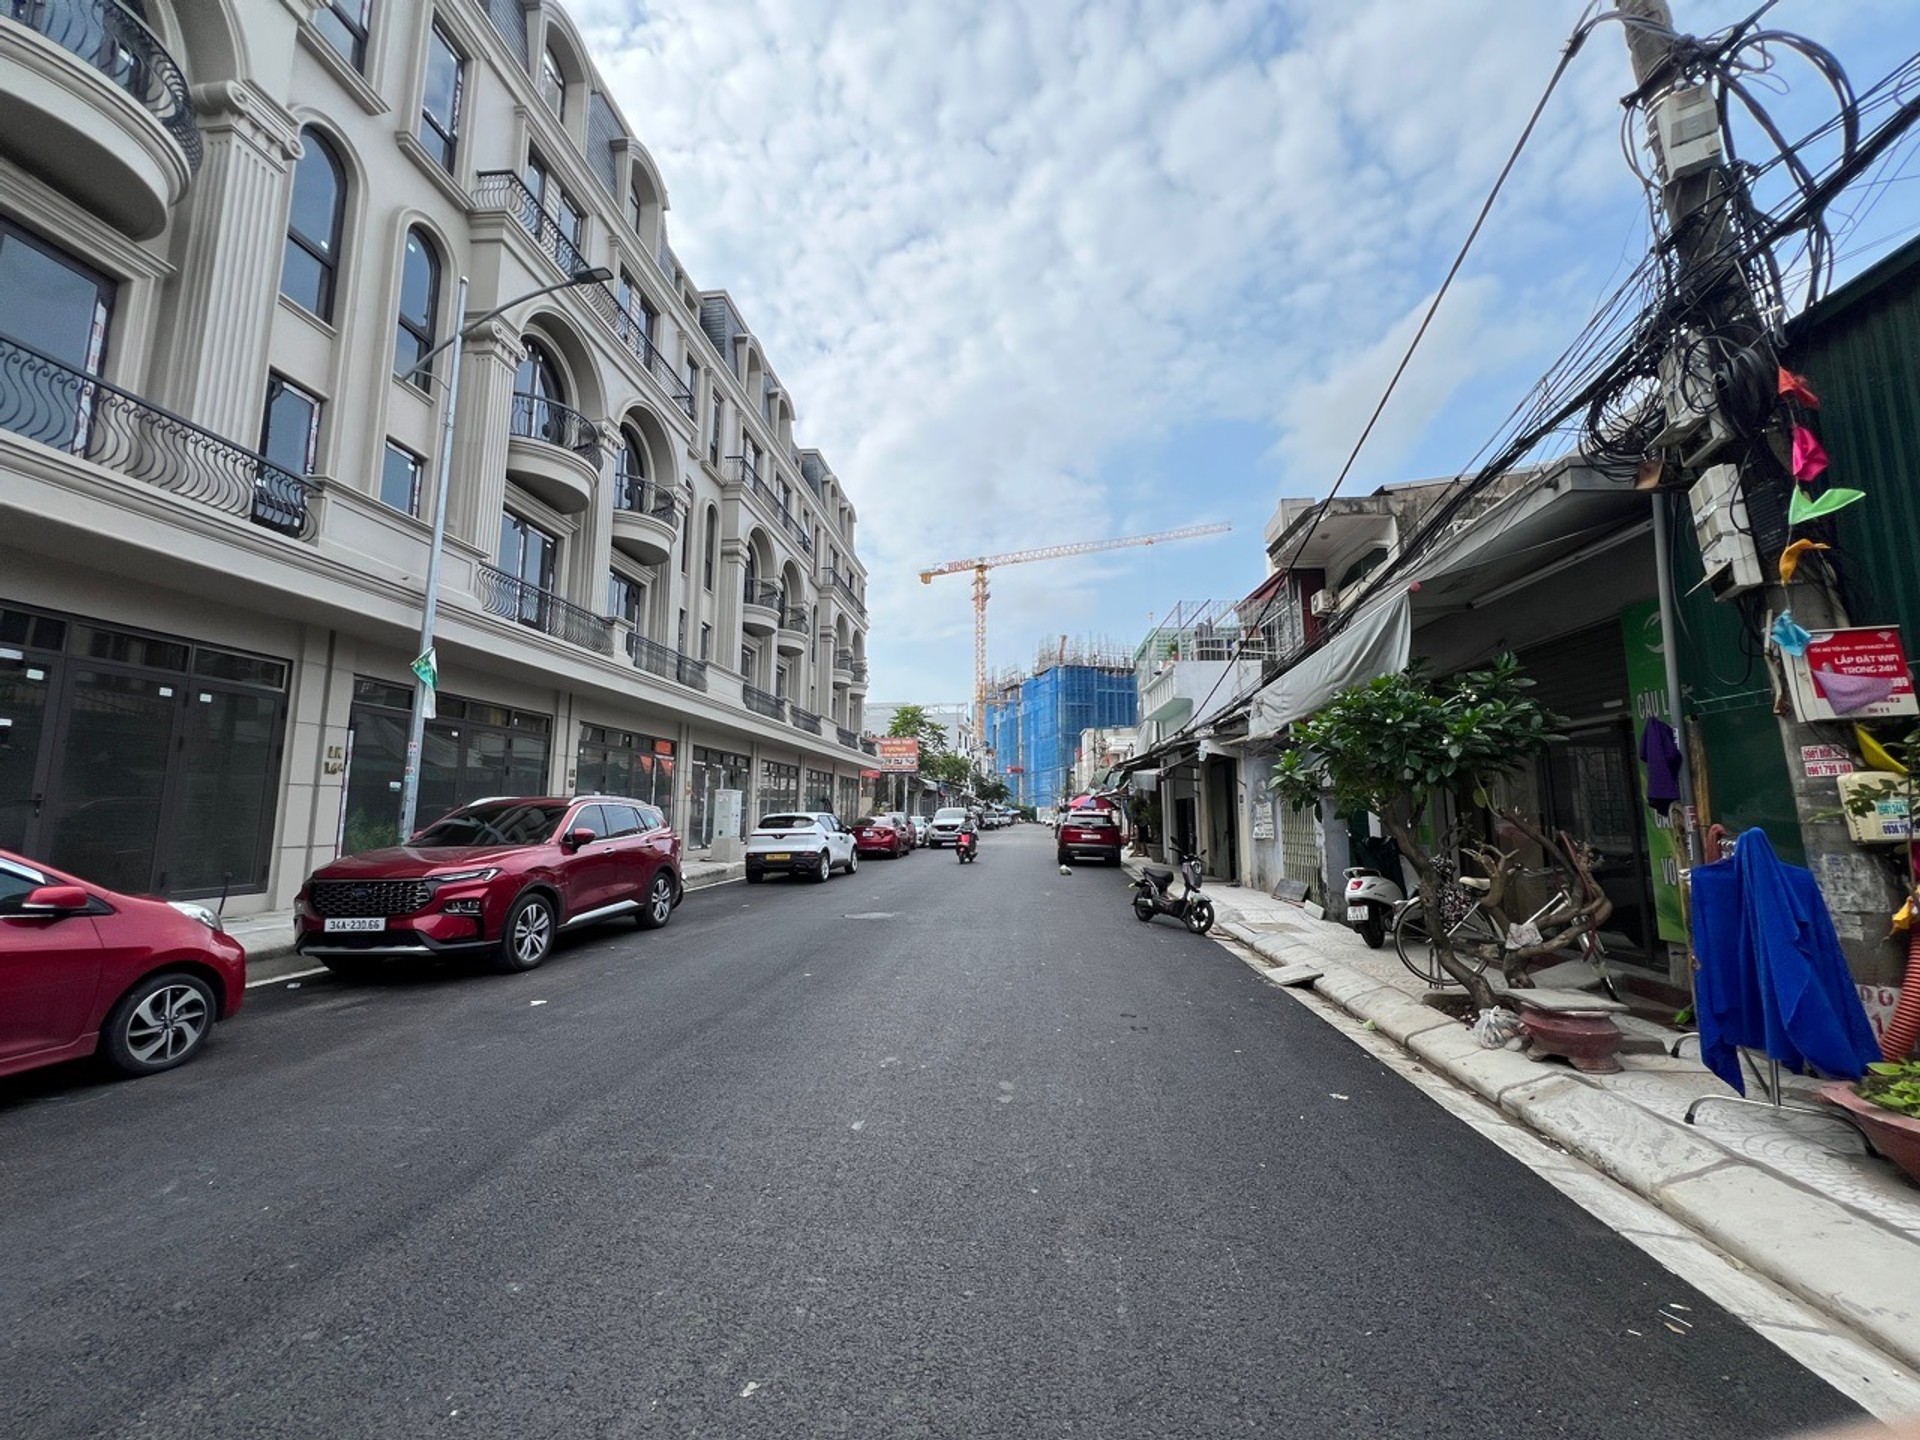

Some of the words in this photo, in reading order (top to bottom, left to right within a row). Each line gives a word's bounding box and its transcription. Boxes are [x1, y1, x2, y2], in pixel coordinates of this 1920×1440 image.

[1876, 654, 1900, 663] WIFI
[1841, 666, 1877, 674] TRONG
[1877, 664, 1898, 672] 24H
